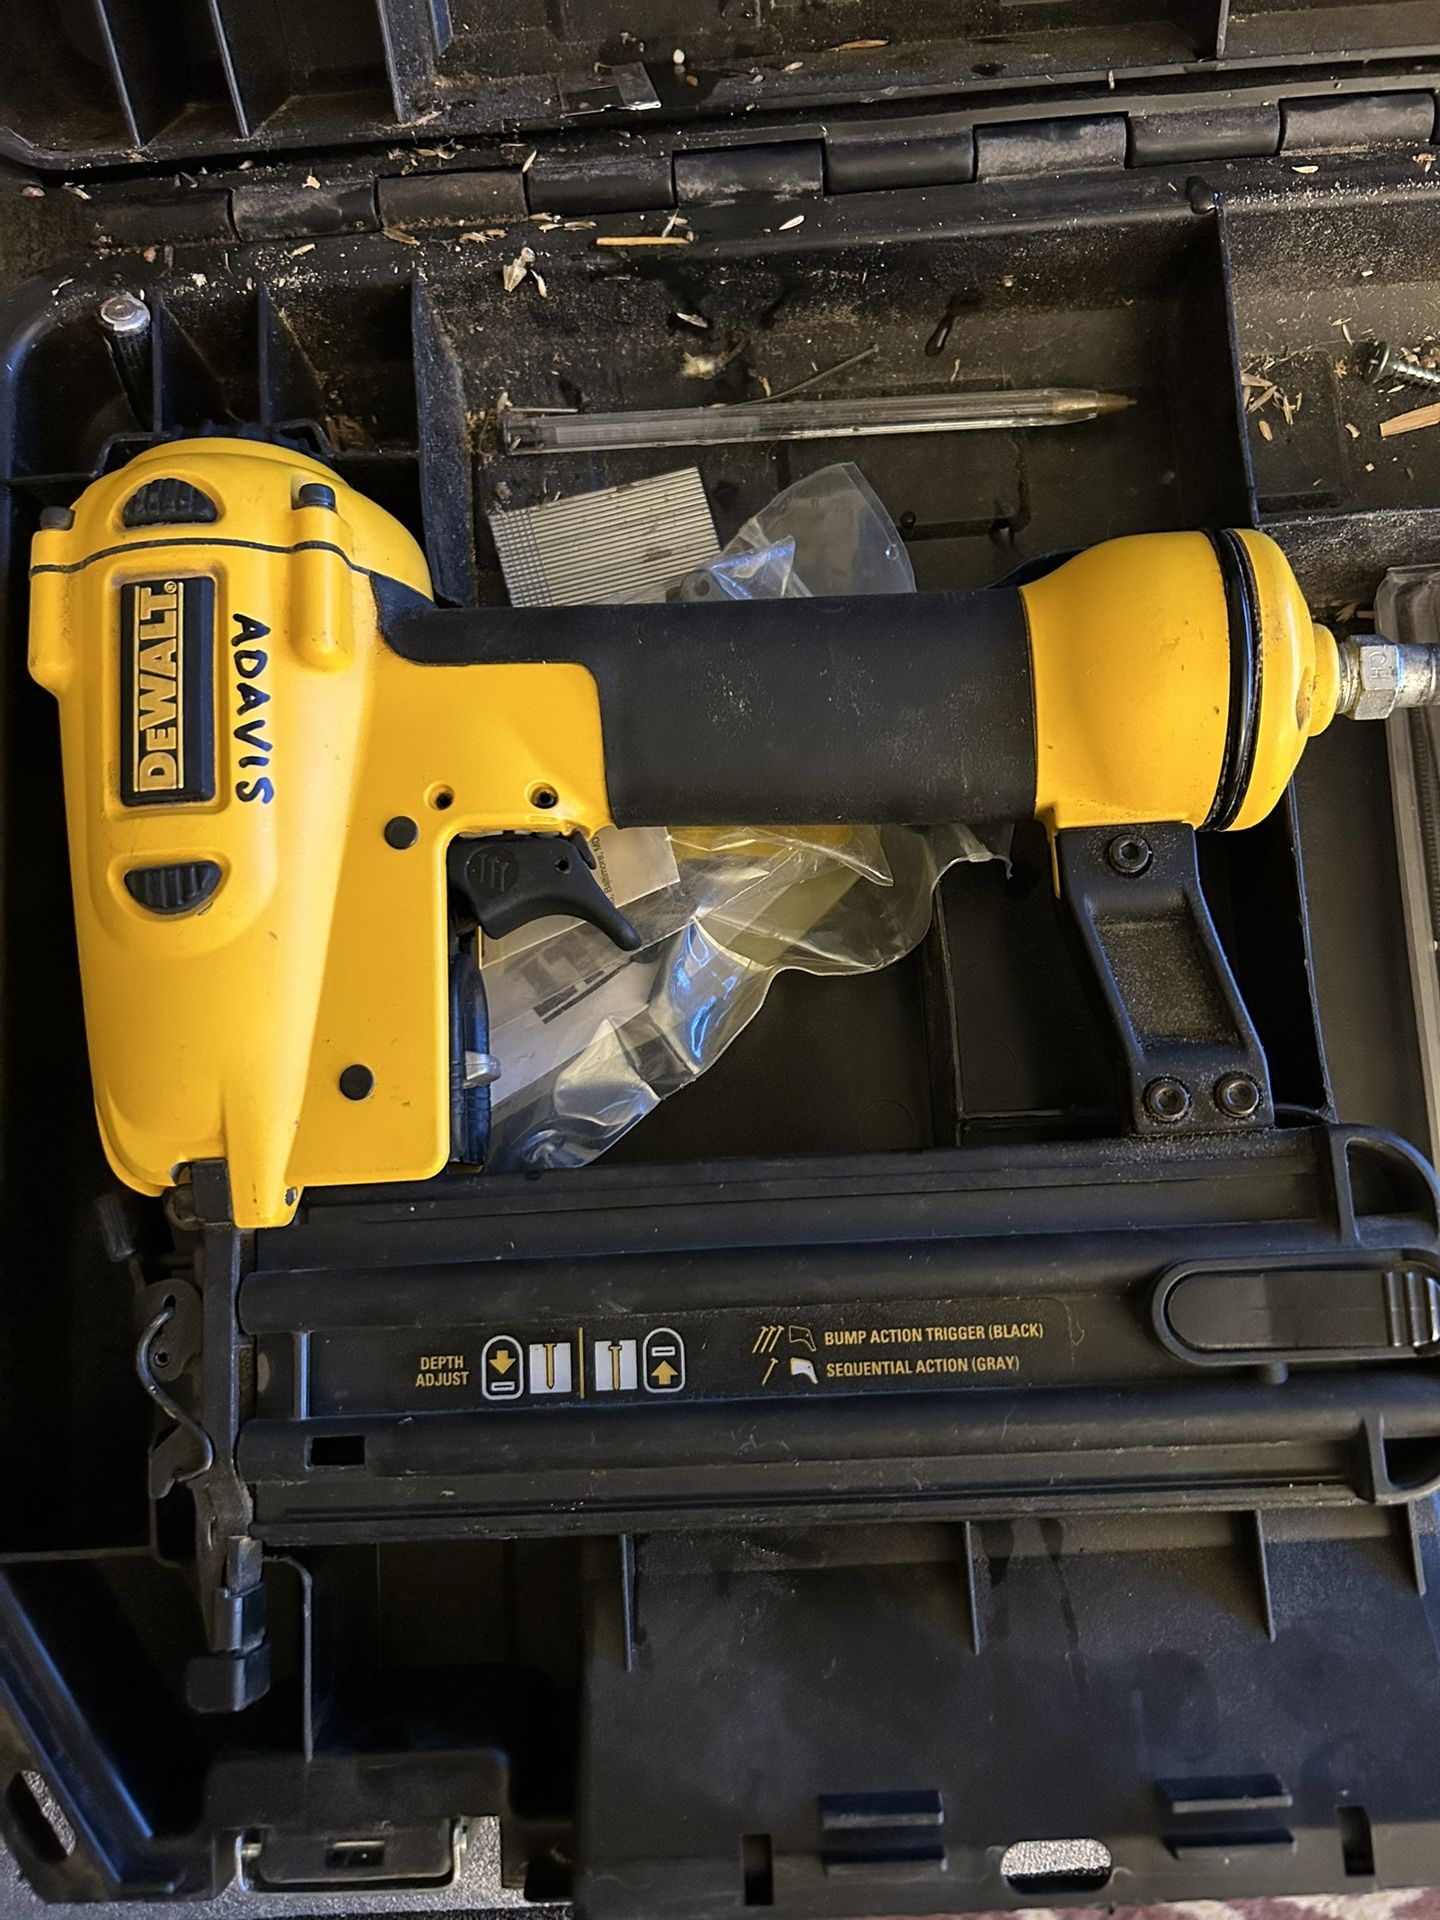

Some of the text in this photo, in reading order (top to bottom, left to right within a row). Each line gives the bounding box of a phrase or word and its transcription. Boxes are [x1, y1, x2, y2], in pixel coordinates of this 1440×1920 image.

[592, 836, 601, 852] MD
[597, 851, 613, 894] Baltimore,
[824, 1323, 1044, 1346] BUMP ACTION TRIGGER (BLACK)
[420, 1355, 464, 1371] DEPTH
[826, 1355, 1020, 1378] SEQUENTIAL ACTION (GRAY)
[416, 1371, 470, 1388] ADJUST
